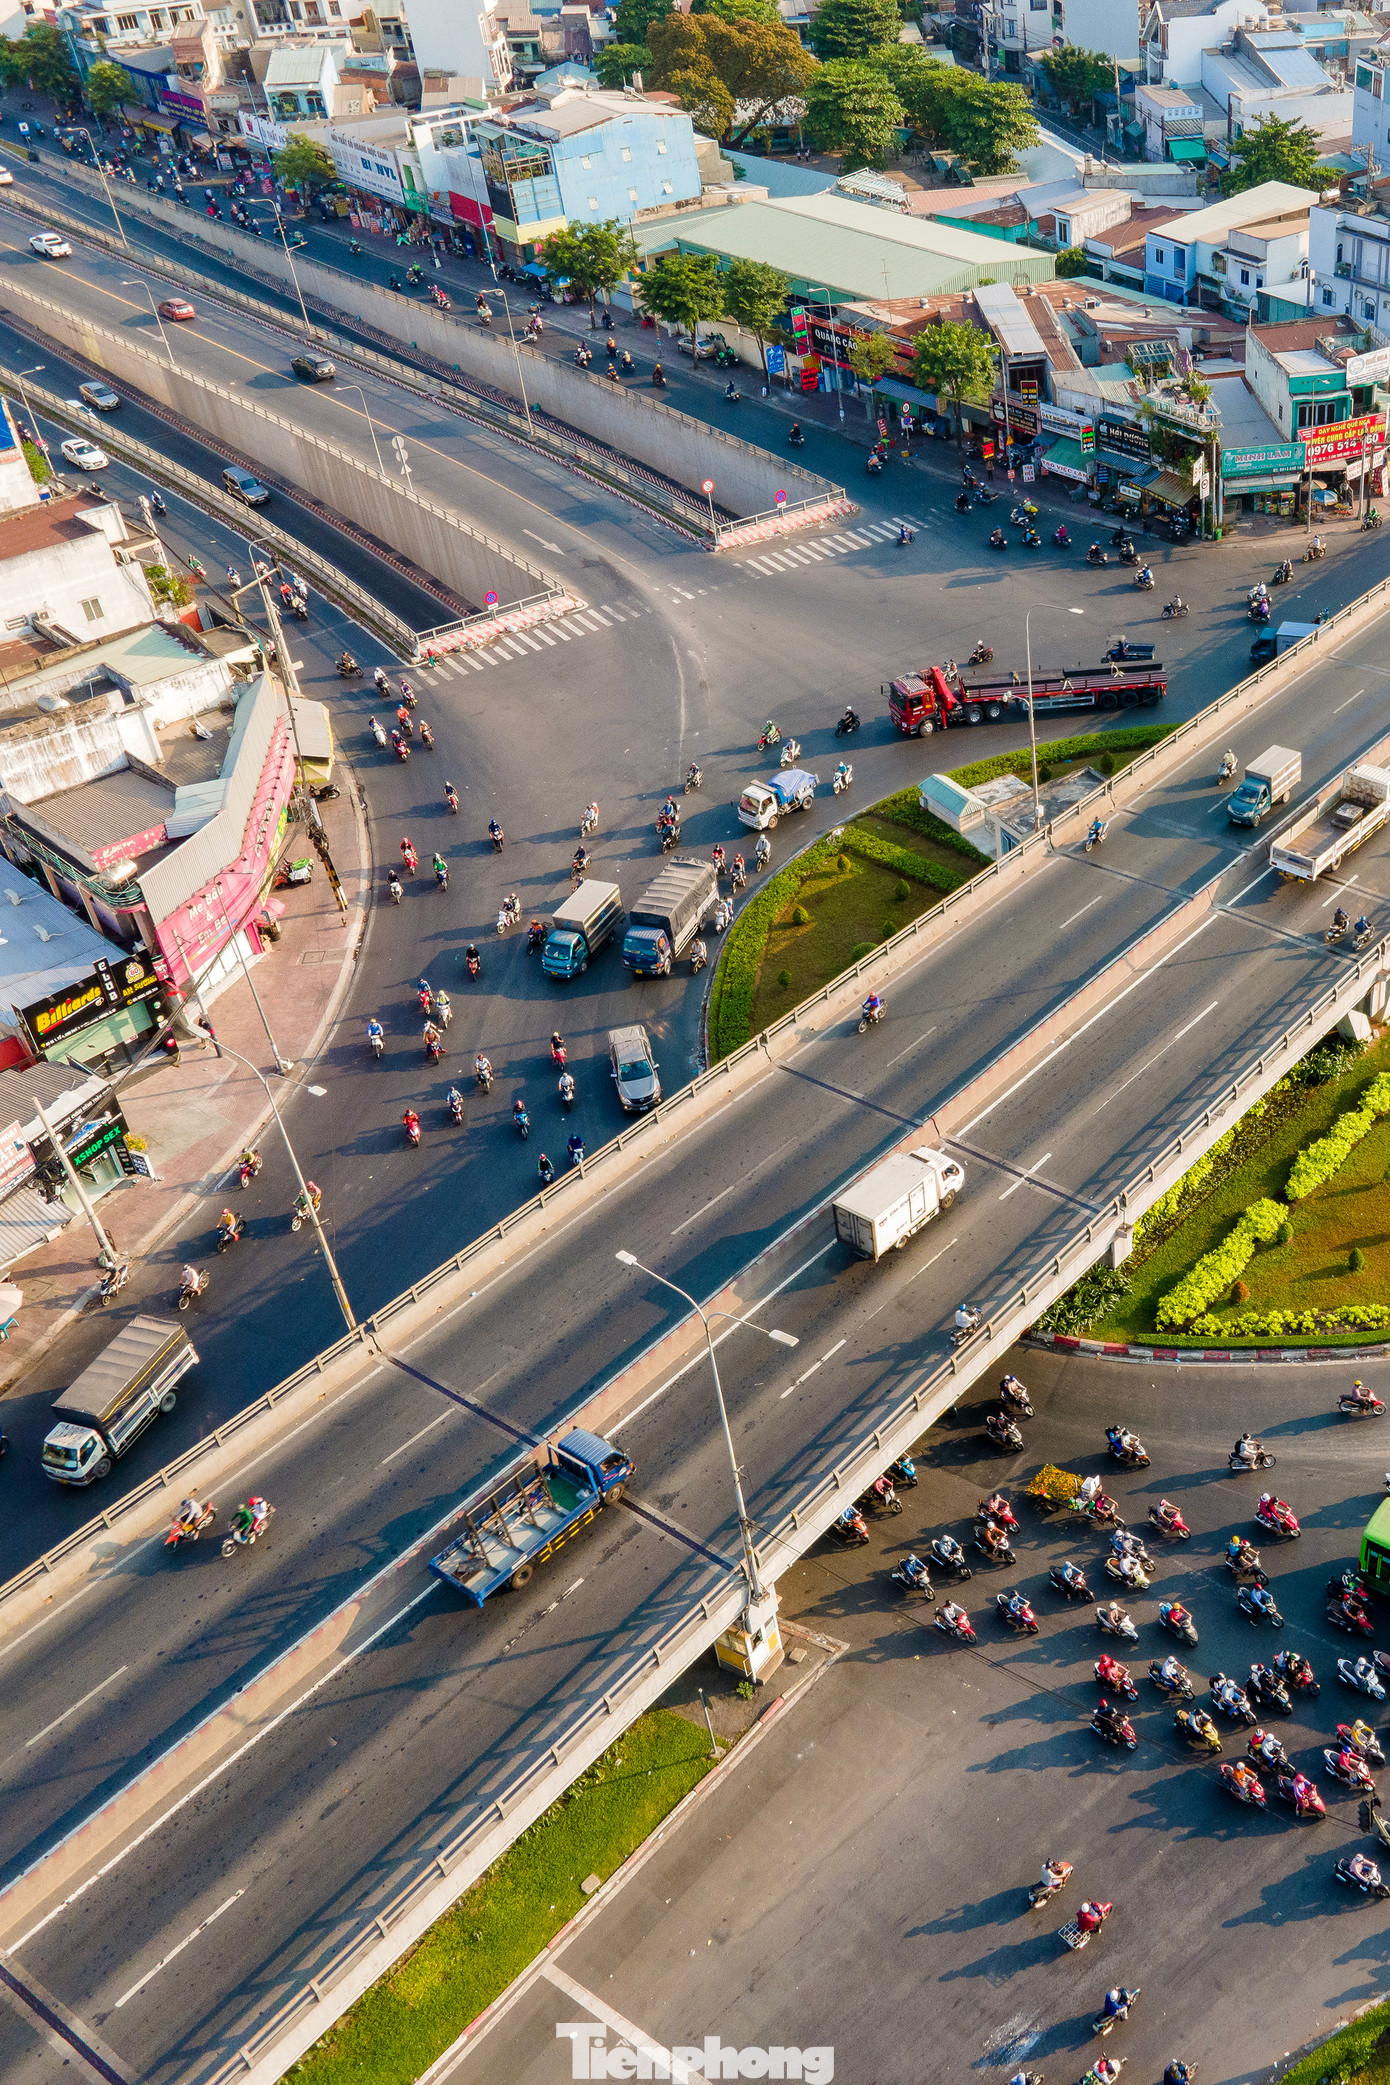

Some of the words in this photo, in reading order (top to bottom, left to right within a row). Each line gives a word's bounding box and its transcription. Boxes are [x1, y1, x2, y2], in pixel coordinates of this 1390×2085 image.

[36, 986, 102, 1033] Billiards
[122, 986, 133, 997] AN
[73, 1139, 103, 1166] XSHOP
[103, 1125, 121, 1144] SEX
